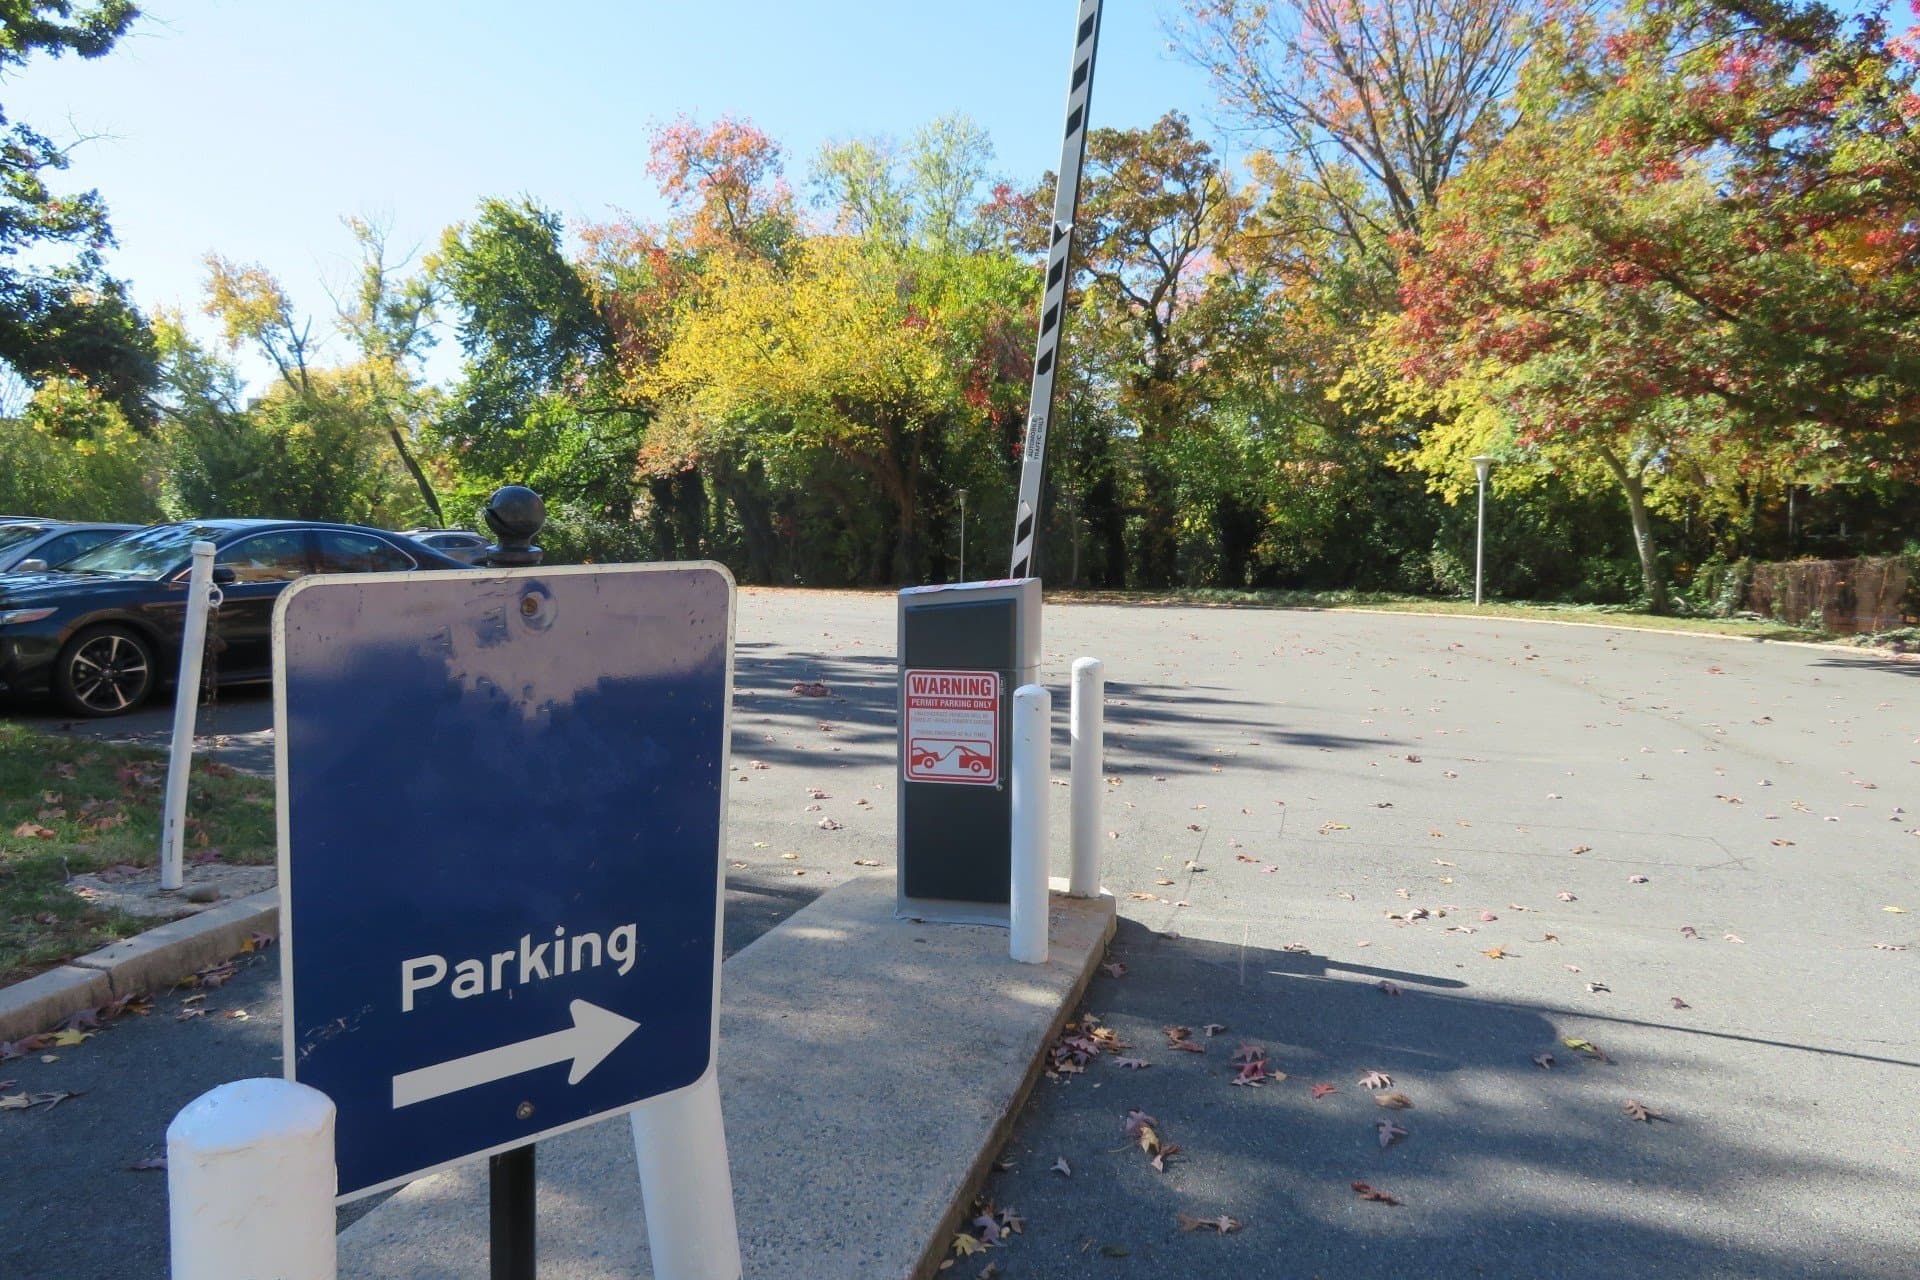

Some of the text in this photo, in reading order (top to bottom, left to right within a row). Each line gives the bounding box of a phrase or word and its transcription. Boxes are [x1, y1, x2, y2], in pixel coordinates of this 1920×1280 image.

[1034, 435, 1042, 460] TRAFFIC
[912, 677, 992, 696] WARNING
[911, 699, 992, 709] PERMIT PARKING ONLY
[402, 923, 637, 1012] Parking
